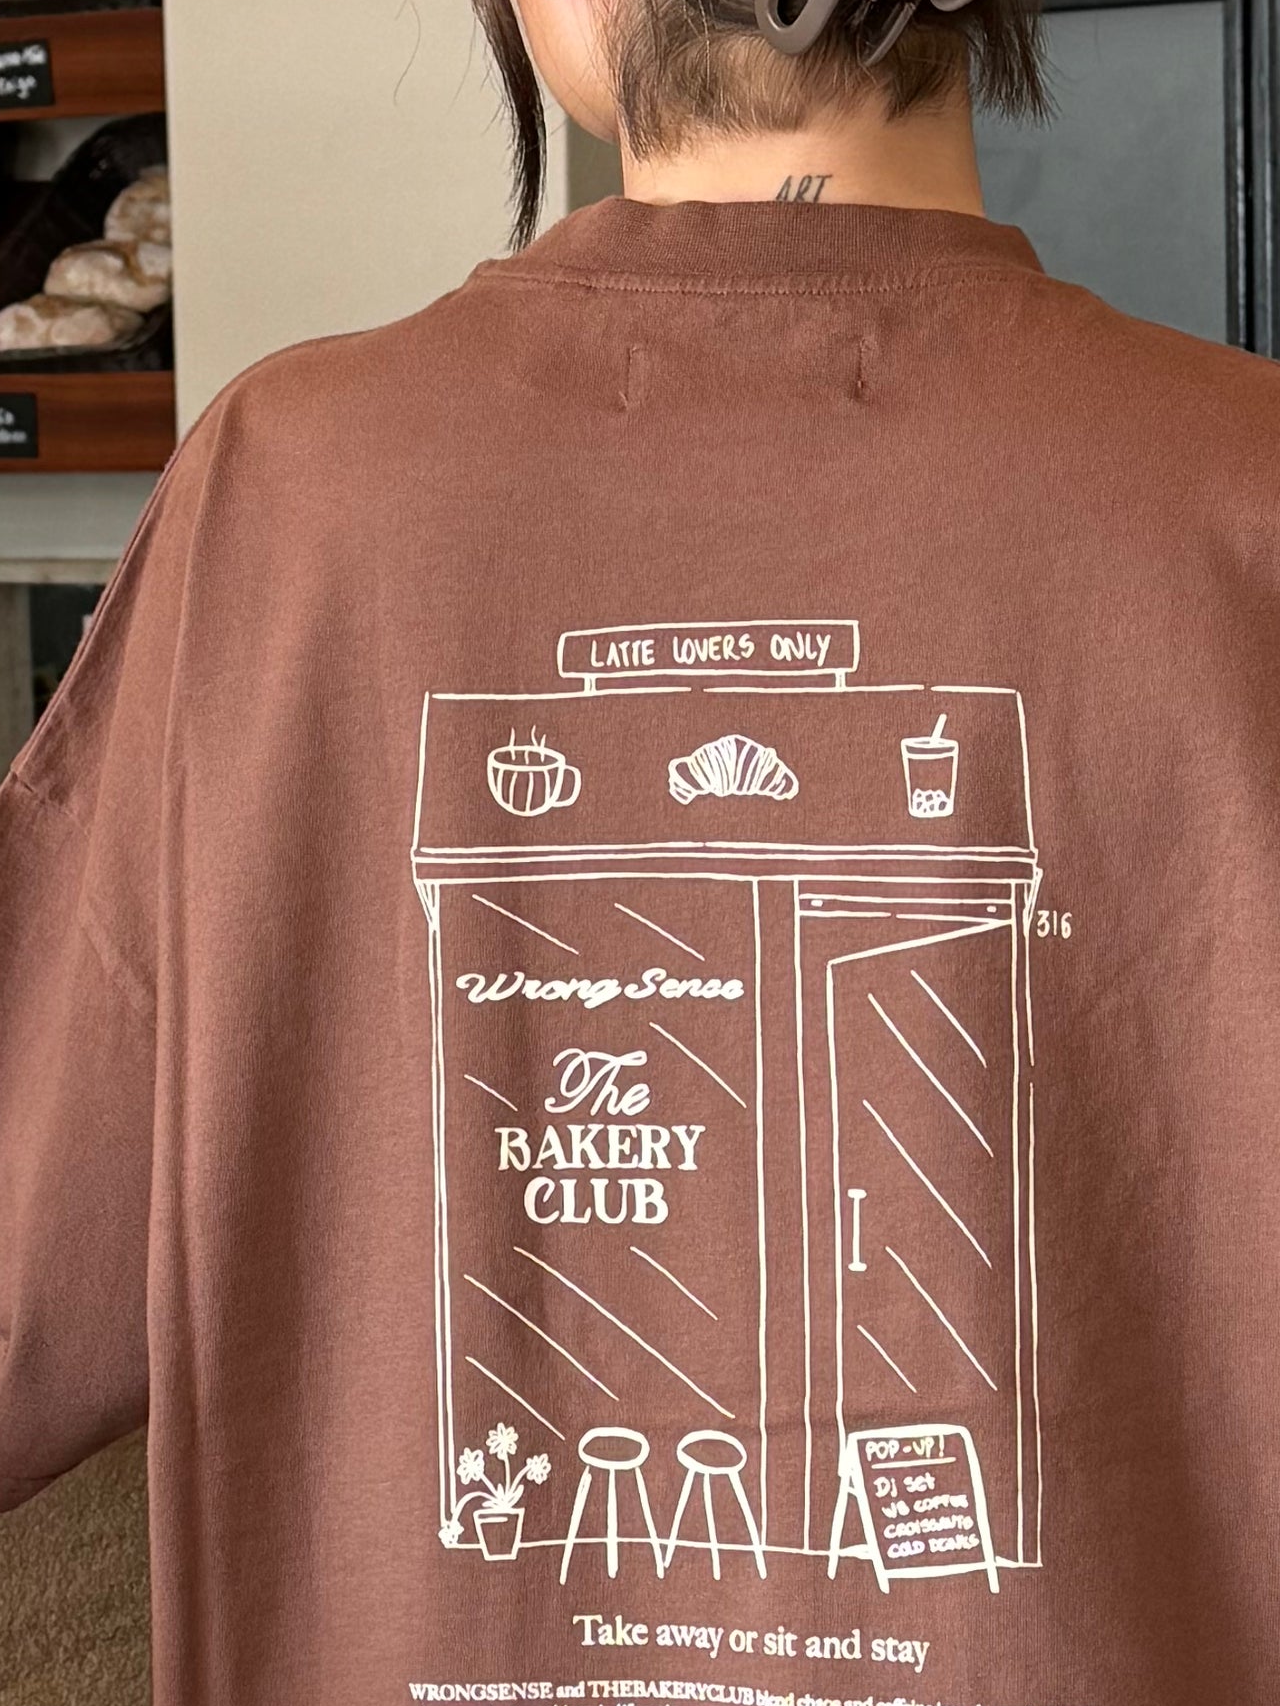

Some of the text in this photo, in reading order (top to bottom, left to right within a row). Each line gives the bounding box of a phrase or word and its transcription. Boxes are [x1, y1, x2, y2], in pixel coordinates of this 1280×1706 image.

[590, 631, 832, 668] LATTE LOVERS ONLY
[1036, 910, 1072, 938] 316
[456, 967, 744, 1009] Wrong Sense
[544, 1048, 650, 1116] The
[494, 1123, 705, 1171] BAKERY
[523, 1178, 669, 1225] CLUB
[887, 1540, 925, 1559] COLD
[573, 1615, 930, 1673] Take away or sit and stay
[408, 1682, 554, 1701] WRONGSENSE
[556, 1680, 585, 1698] and
[587, 1680, 754, 1705] THEBAKERYCLUB
